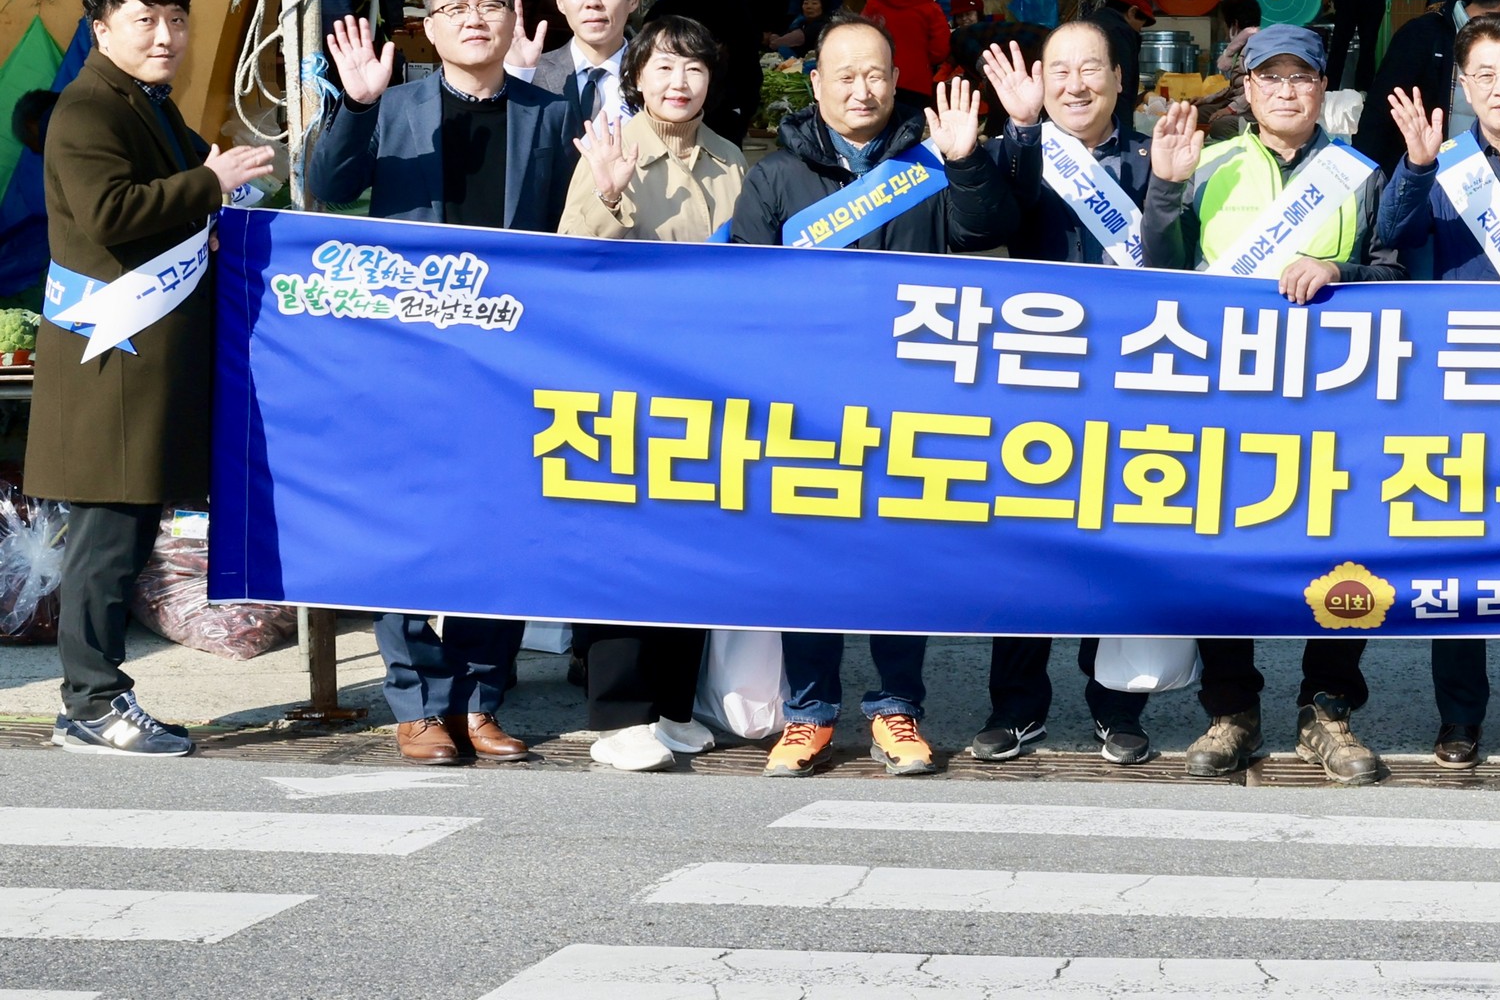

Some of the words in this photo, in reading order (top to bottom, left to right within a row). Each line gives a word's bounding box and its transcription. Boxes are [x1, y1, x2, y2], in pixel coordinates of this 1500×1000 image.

[1041, 137, 1128, 235] 전통시장을
[318, 244, 356, 282] 일
[357, 249, 417, 284] 잘하는
[422, 257, 484, 292] 의회
[333, 288, 391, 314] 맛나는
[400, 295, 519, 327] 전라남도의회
[892, 283, 1088, 389] 작은
[1113, 299, 1413, 400] 소비가
[532, 387, 1349, 538] 전라남도의회가
[1328, 593, 1371, 611] 의회
